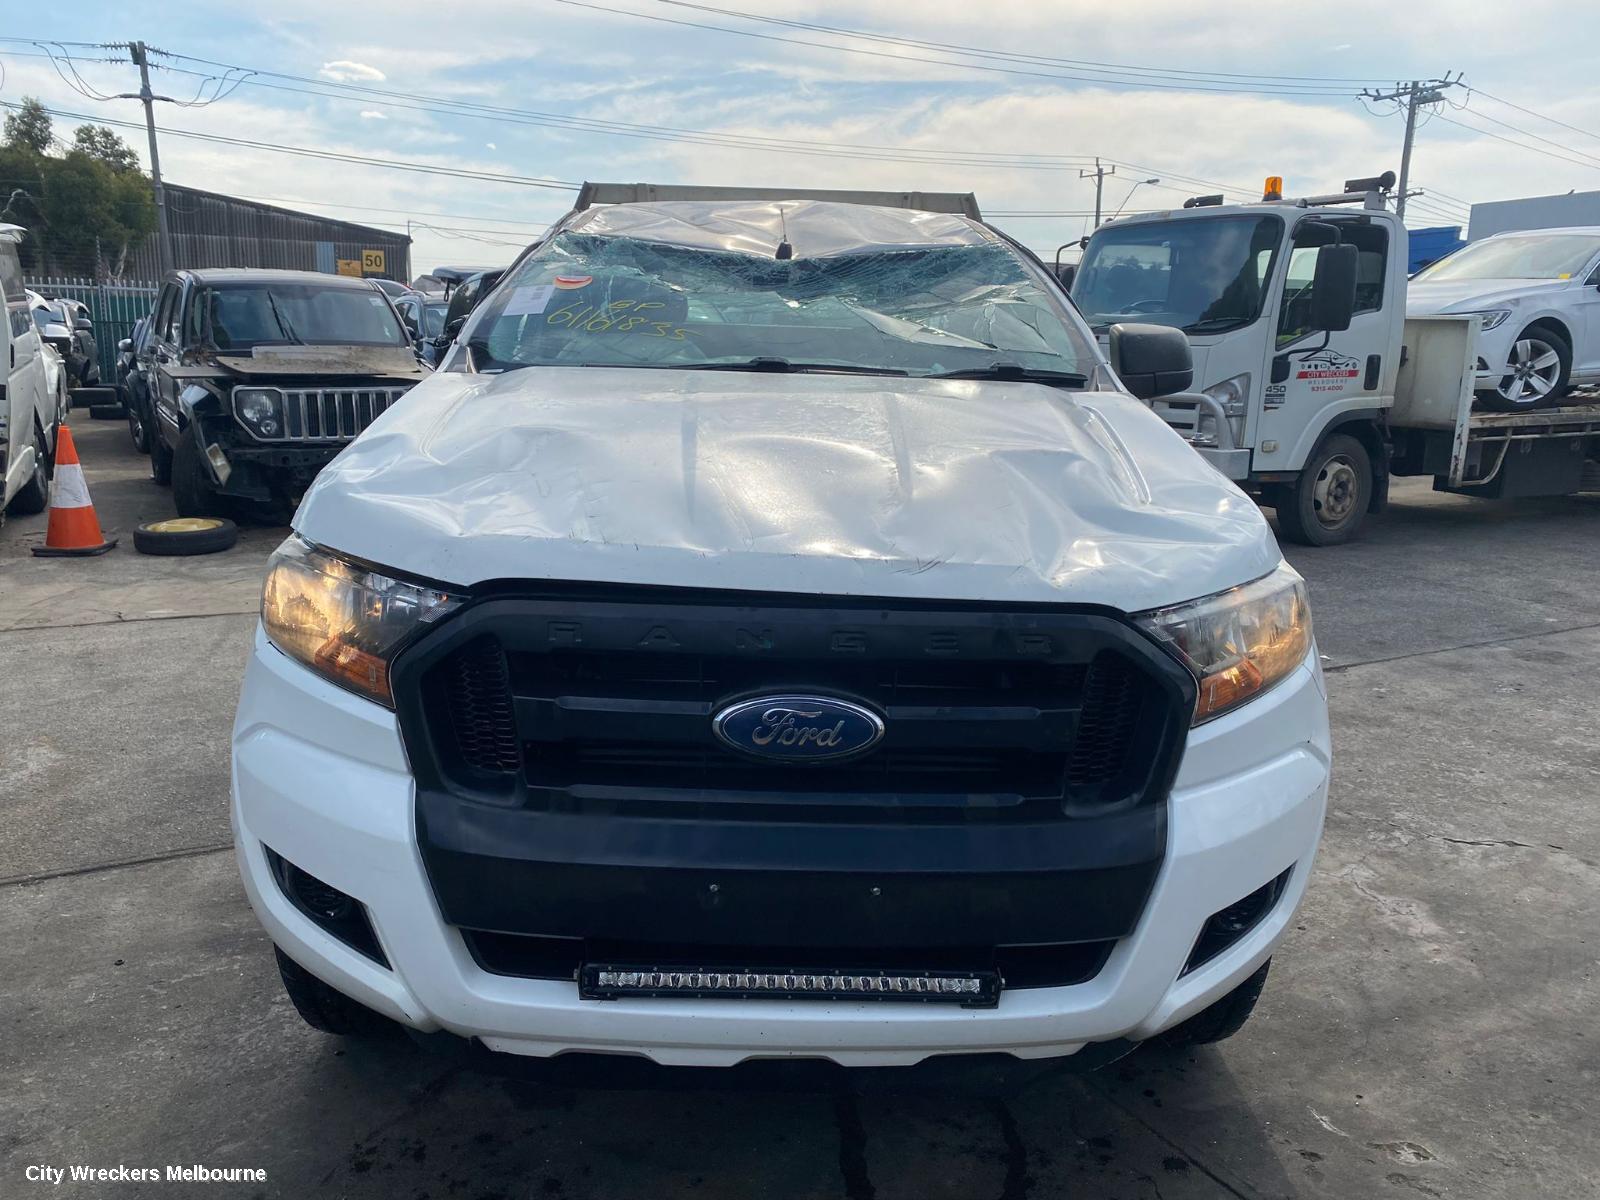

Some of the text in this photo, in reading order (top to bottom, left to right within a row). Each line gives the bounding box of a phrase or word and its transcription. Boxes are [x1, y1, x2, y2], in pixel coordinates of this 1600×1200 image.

[365, 254, 382, 267] 50
[1265, 385, 1287, 393] 450
[546, 620, 1056, 656] RANGER
[752, 708, 843, 747] Ford
